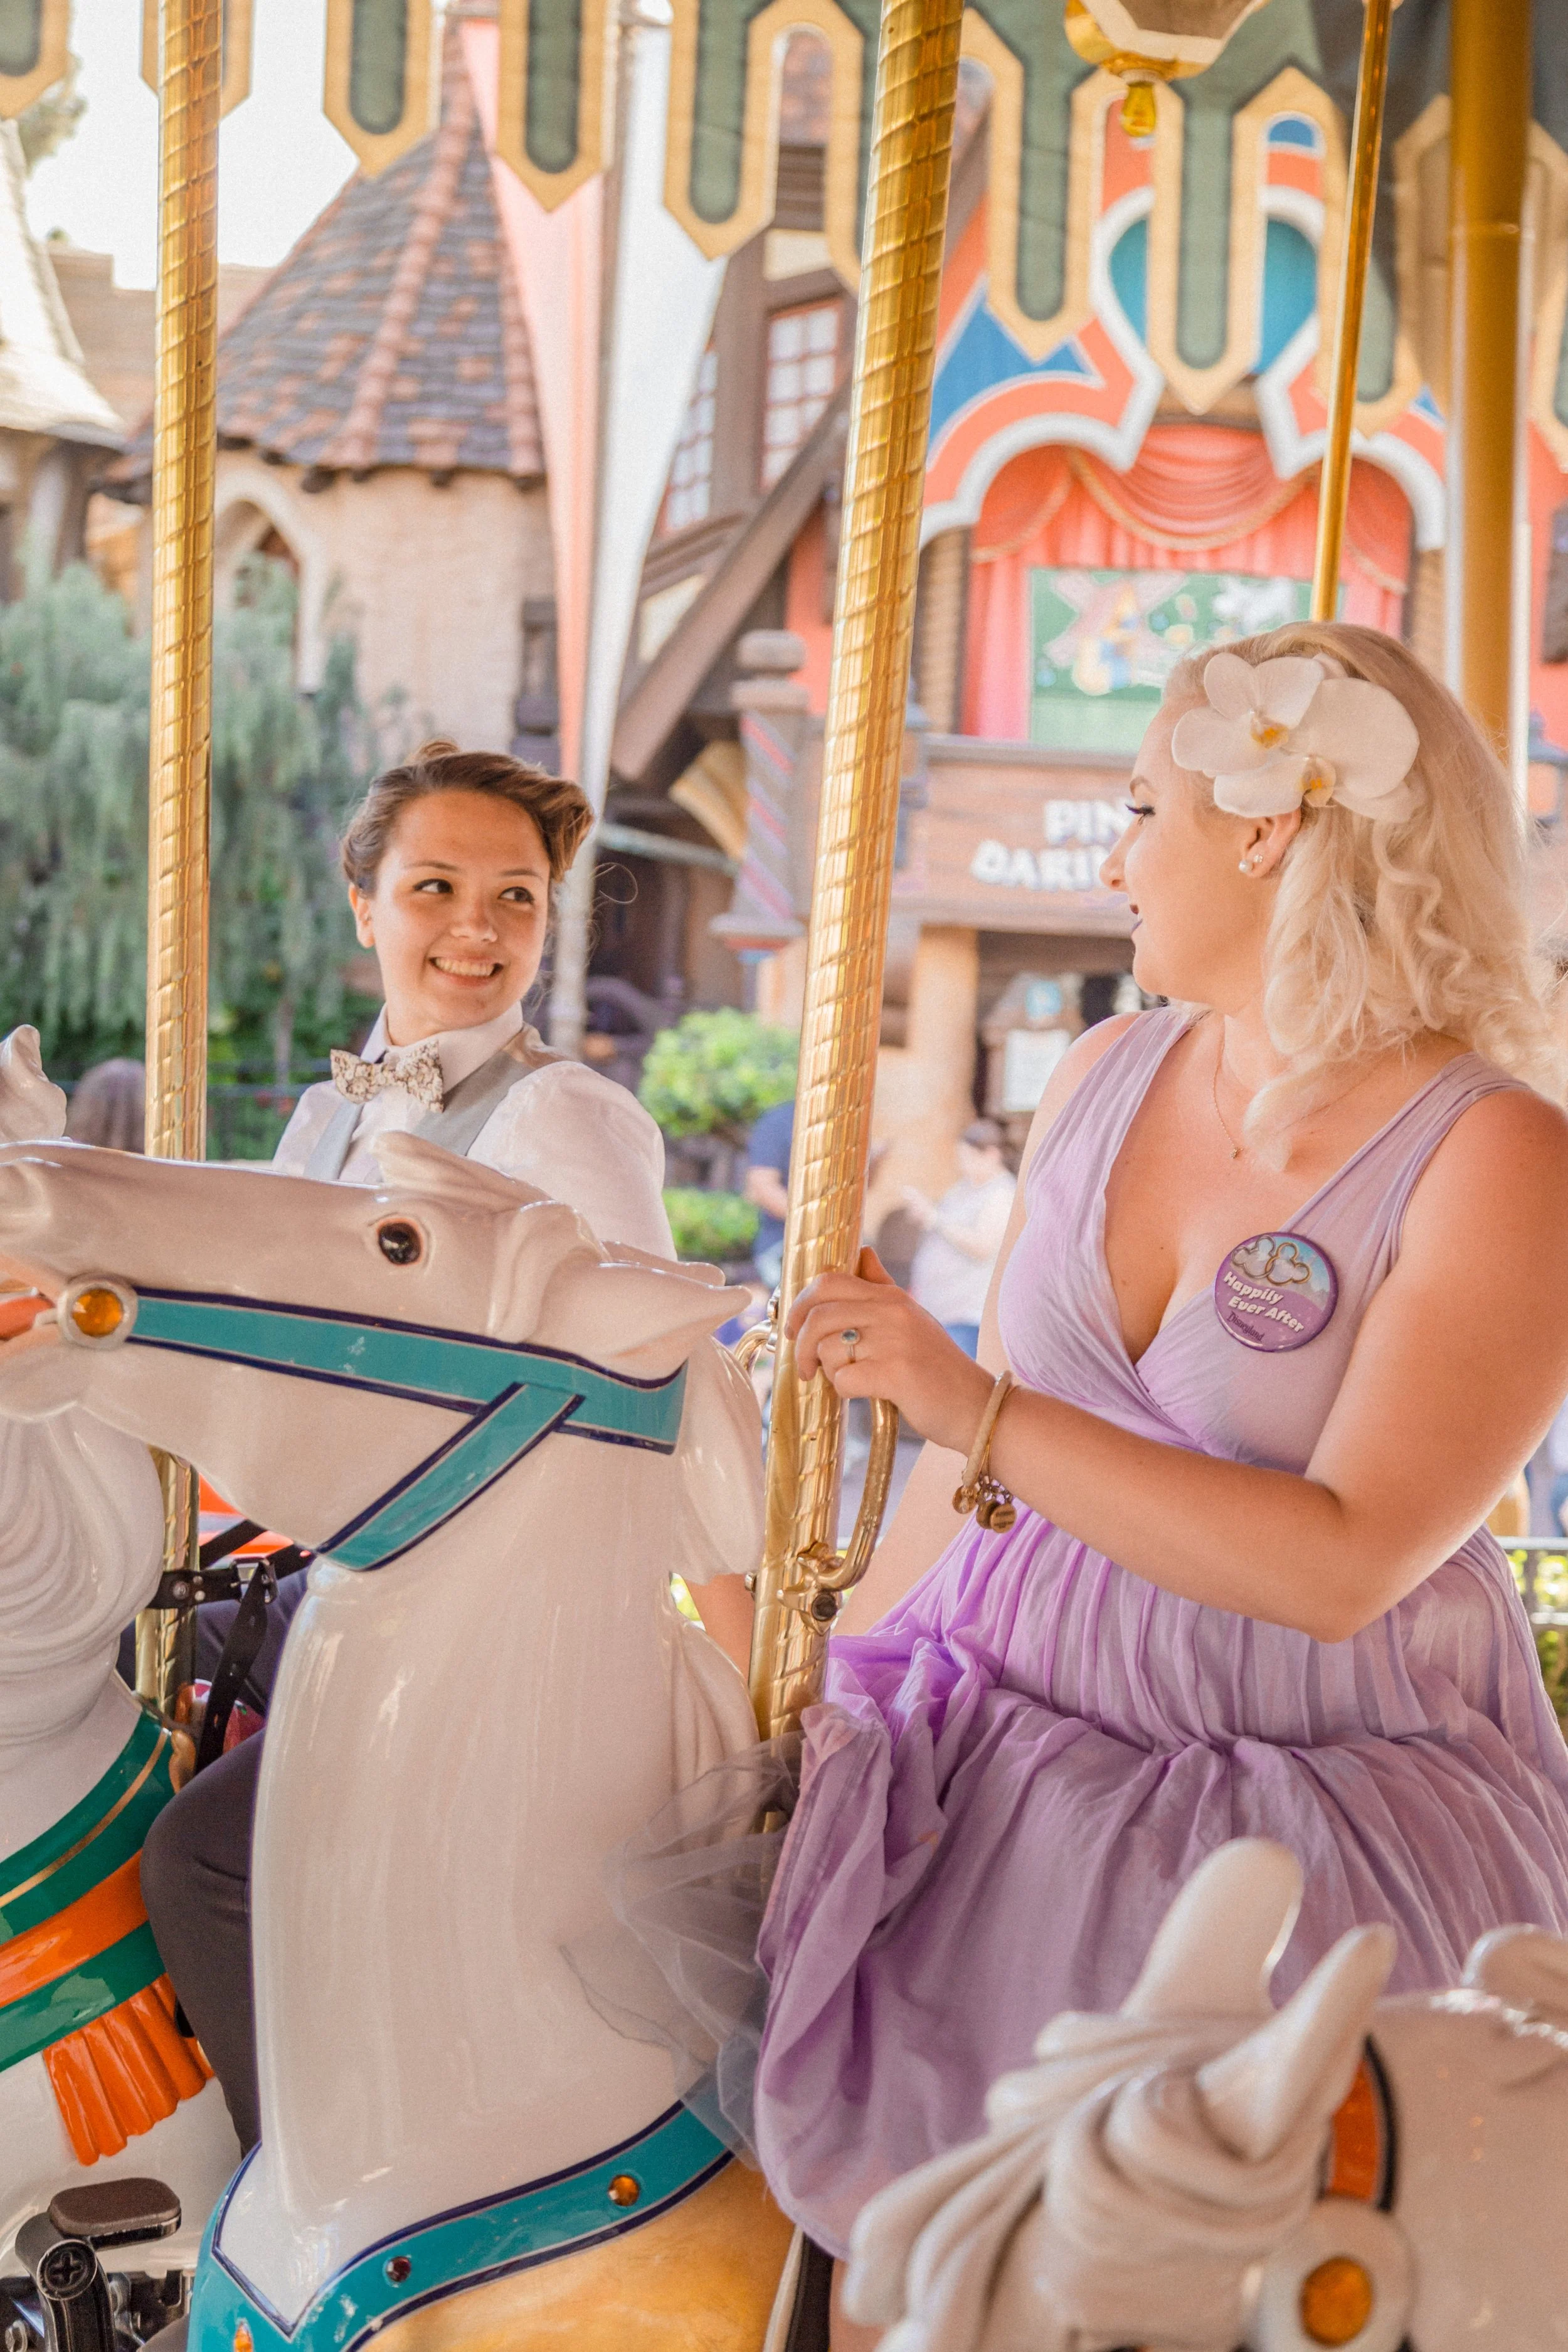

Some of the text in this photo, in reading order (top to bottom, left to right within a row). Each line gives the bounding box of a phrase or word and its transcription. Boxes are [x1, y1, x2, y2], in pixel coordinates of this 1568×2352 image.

[1223, 1271, 1285, 1305] Happily
[1227, 1311, 1265, 1342] Disneyland
[1228, 1296, 1305, 1333] Ever After
